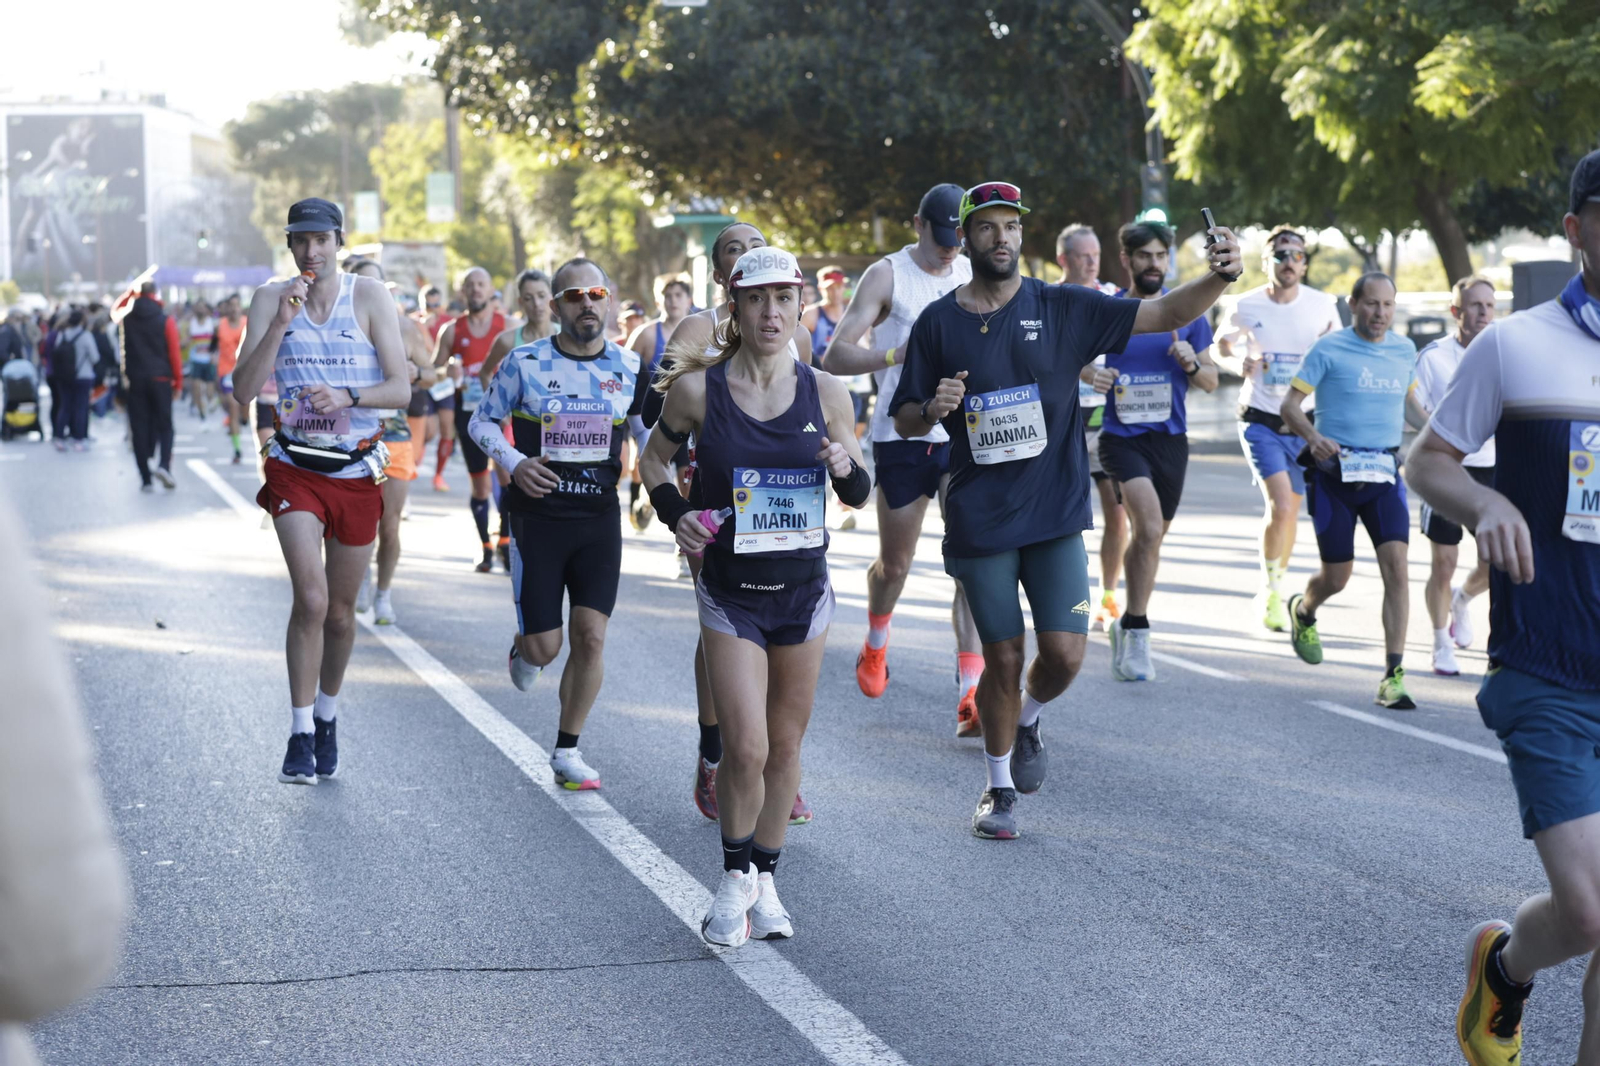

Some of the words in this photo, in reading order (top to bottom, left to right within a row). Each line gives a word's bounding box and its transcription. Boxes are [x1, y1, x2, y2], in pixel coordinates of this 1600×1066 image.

[285, 358, 303, 366] ETON
[306, 358, 338, 366] MANOR
[1133, 375, 1165, 384] ZURICH
[1358, 377, 1402, 389] ULTRA
[599, 379, 622, 393] ego
[987, 390, 1031, 407] ZURICH
[566, 402, 605, 411] ZURICH
[1115, 403, 1146, 411] CONCHI
[1148, 401, 1170, 410] MORA
[566, 420, 587, 430] 9107
[990, 413, 1019, 427] 10435
[544, 430, 608, 446] PEÑALVER
[977, 424, 1038, 447] JUANMA
[766, 472, 817, 485] ZURICH
[767, 497, 795, 509] 7446
[752, 512, 808, 530] MARIN
[740, 582, 785, 591] SALOMON
